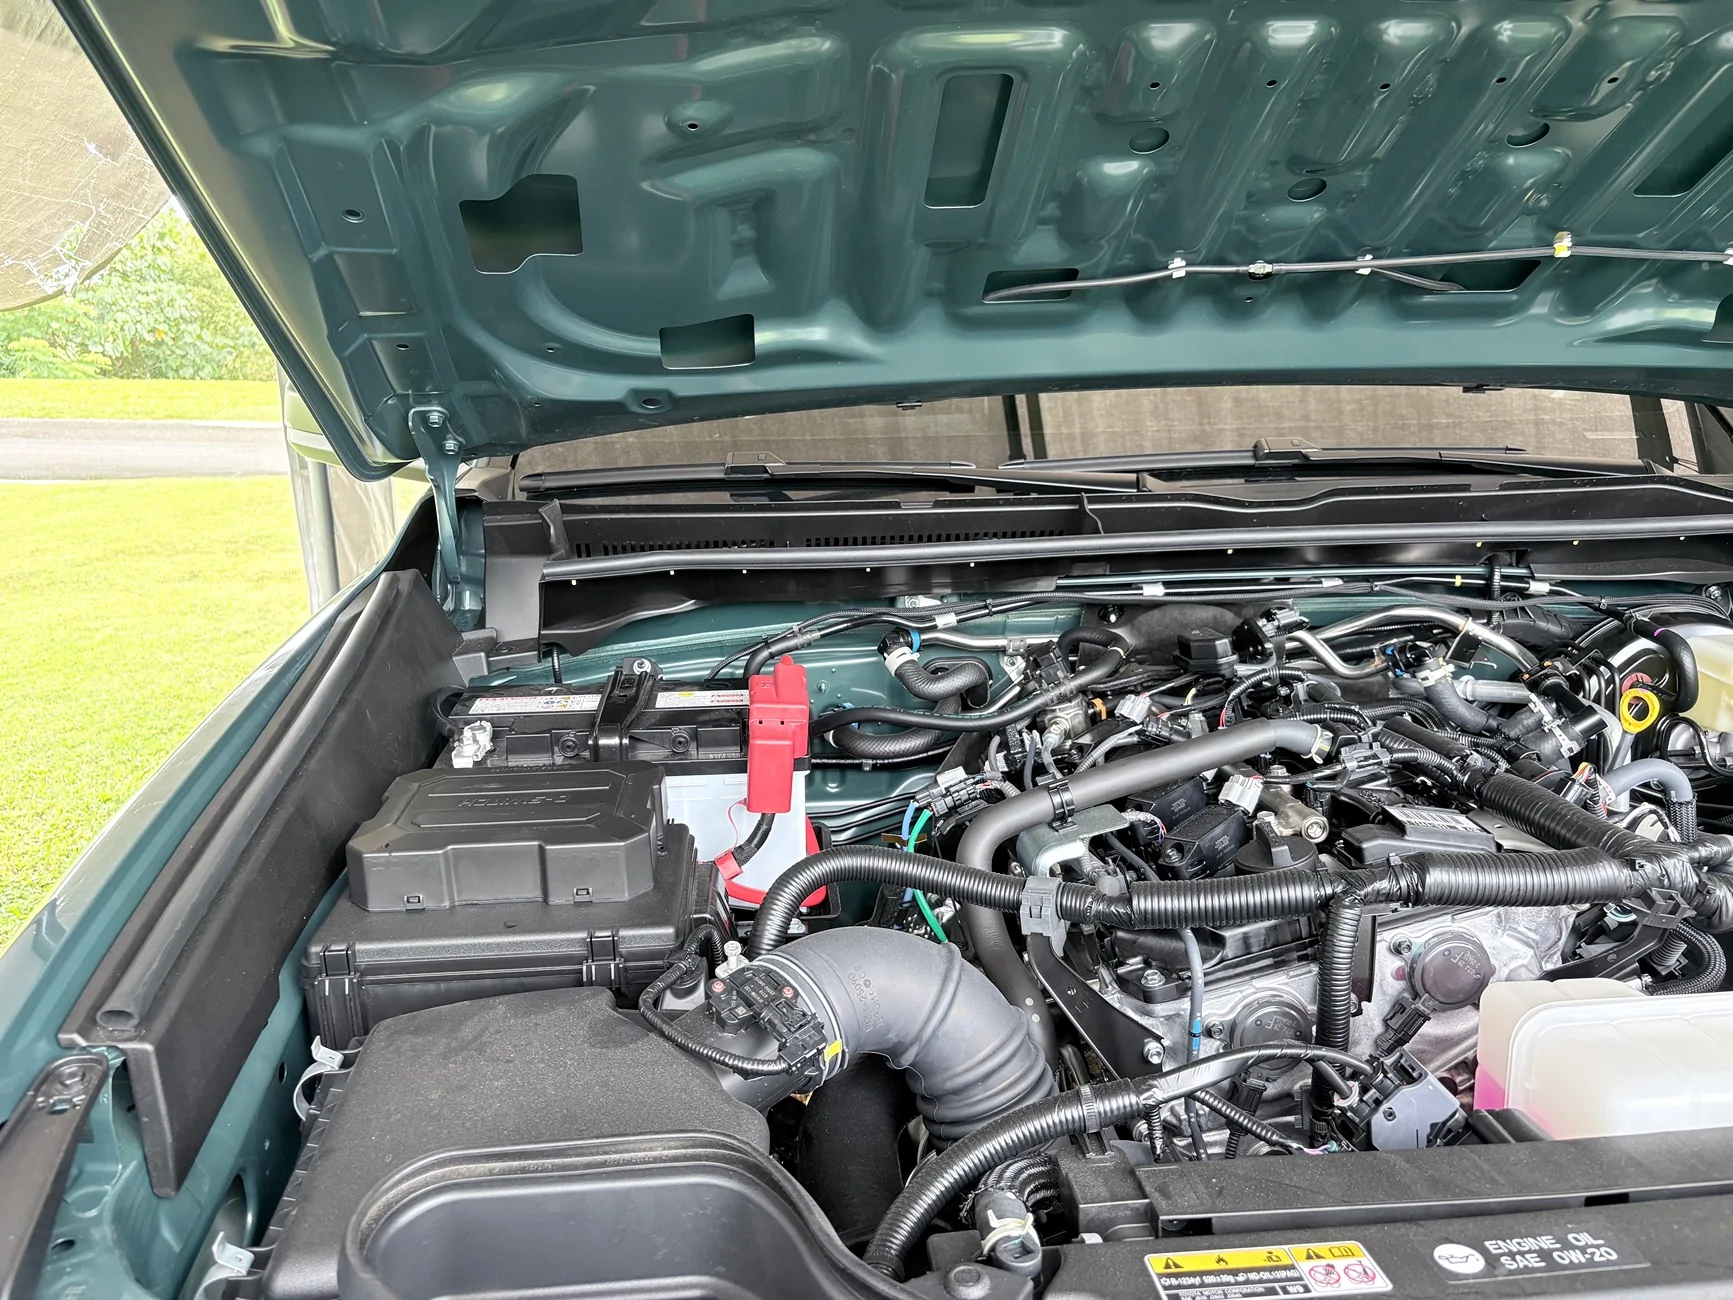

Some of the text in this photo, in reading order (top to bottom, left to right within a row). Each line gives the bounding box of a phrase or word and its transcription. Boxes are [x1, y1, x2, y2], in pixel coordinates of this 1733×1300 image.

[1484, 1232, 1605, 1254] ENGINE OIL
[1499, 1247, 1618, 1270] SAE 0W-20
[1202, 1288, 1224, 1296] MOTOR
[1225, 1286, 1265, 1294] CORPORATION
[1287, 1285, 1304, 1294] W9
